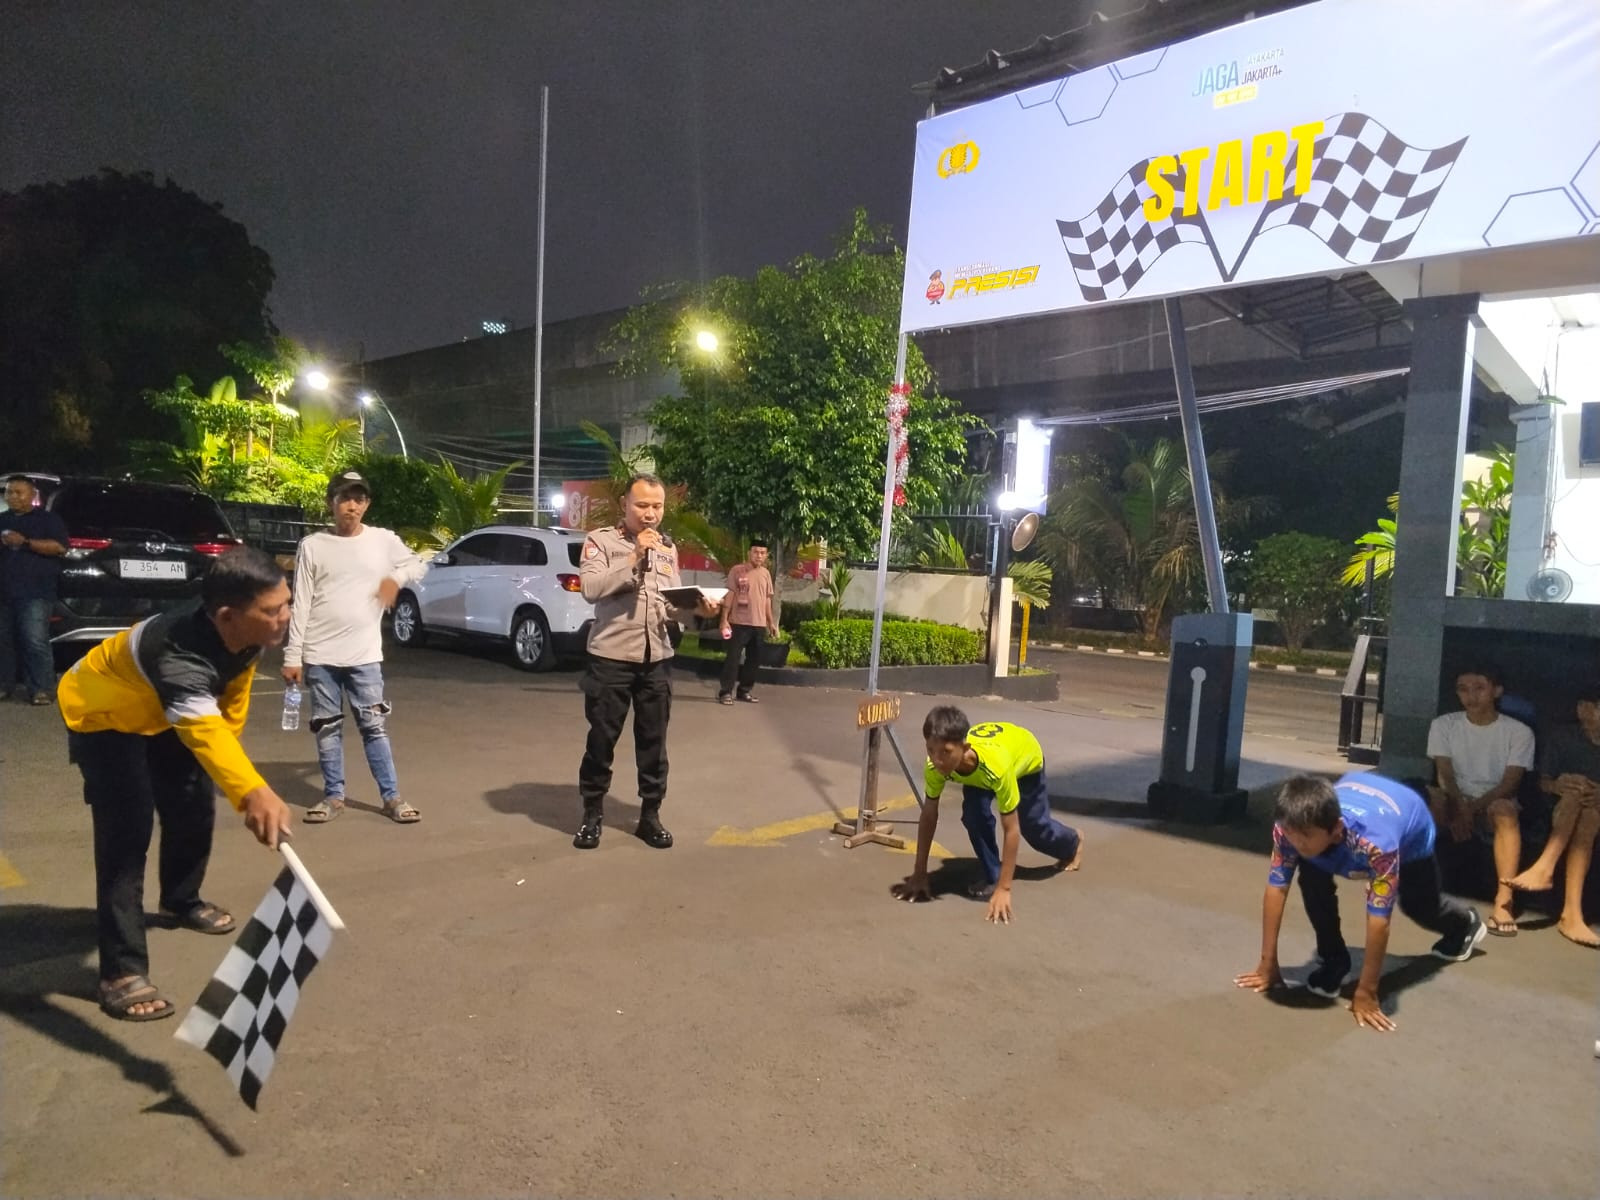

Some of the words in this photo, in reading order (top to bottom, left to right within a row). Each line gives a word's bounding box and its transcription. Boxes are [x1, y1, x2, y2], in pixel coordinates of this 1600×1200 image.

[1245, 48, 1285, 65] AYAKARTA
[1191, 60, 1240, 97] JAGA
[1142, 120, 1326, 223] START
[946, 264, 1041, 300] PRESISI
[122, 561, 129, 571] Z
[140, 562, 158, 572] 354
[170, 563, 184, 573] AN
